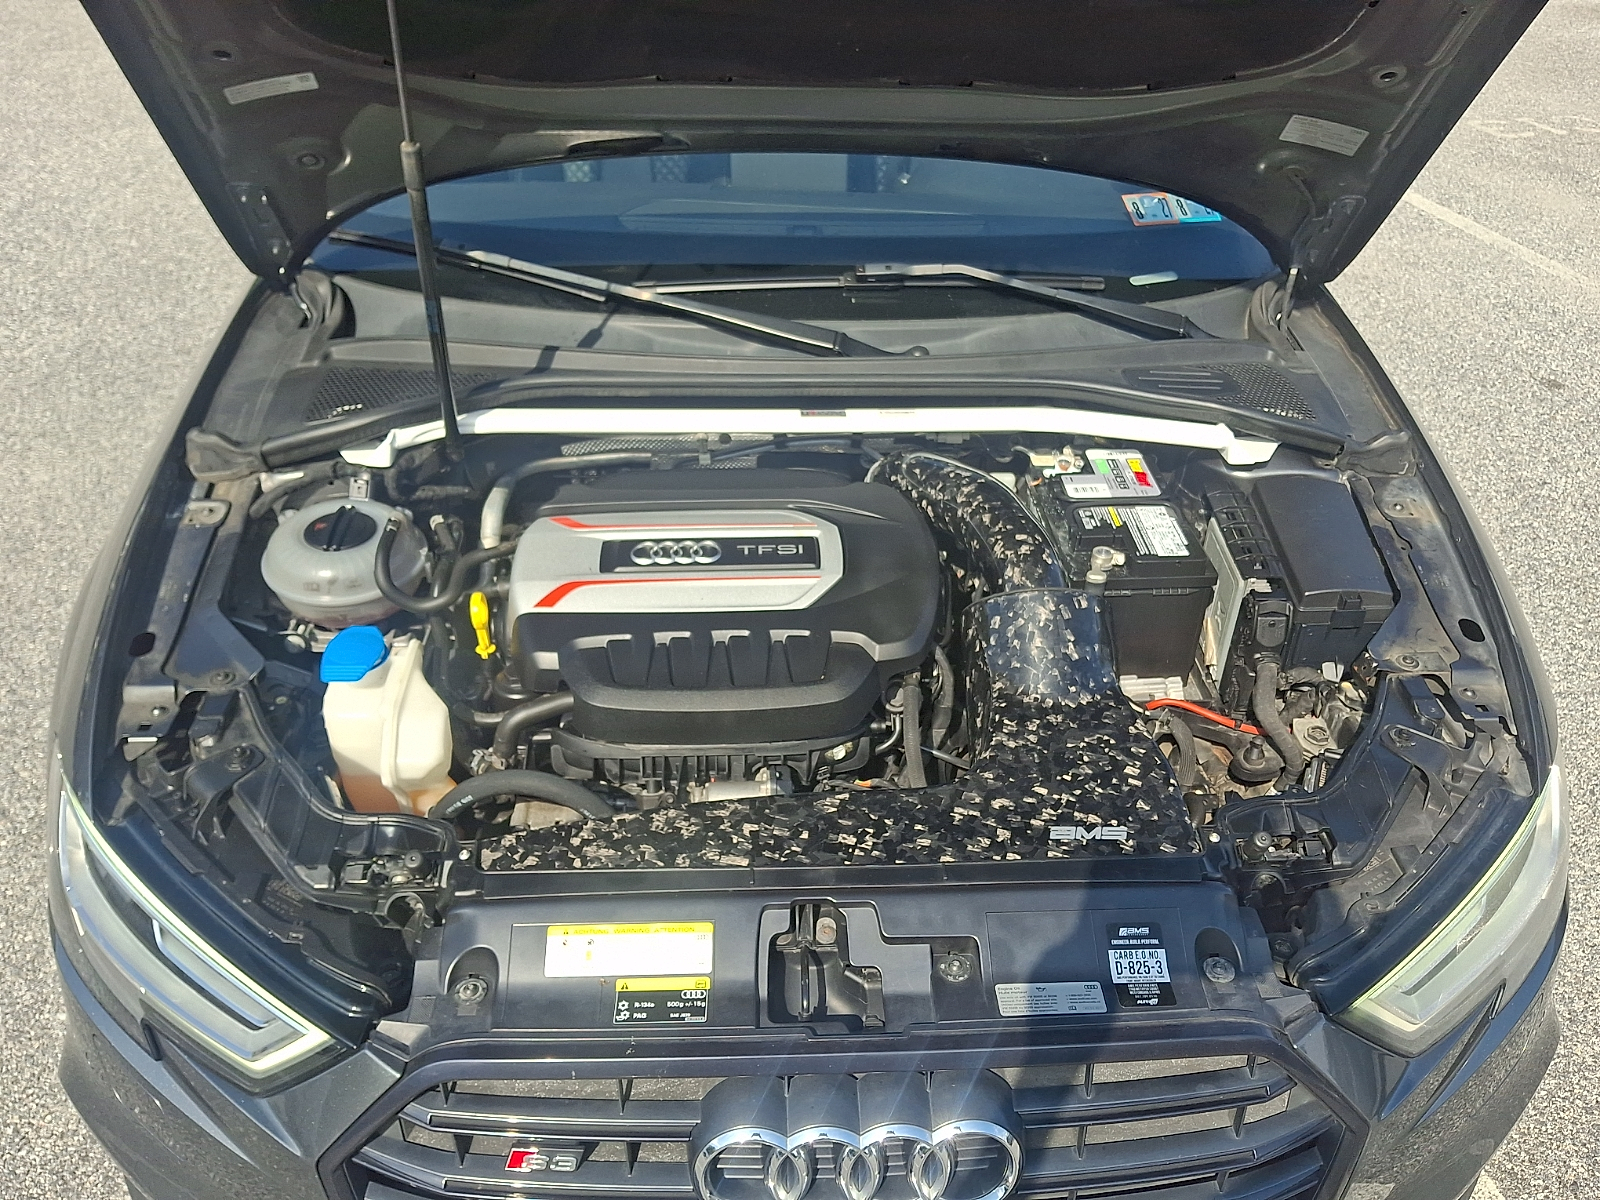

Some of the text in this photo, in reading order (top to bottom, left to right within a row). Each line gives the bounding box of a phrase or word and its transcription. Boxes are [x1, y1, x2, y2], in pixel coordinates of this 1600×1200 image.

[1131, 201, 1144, 219] 8
[1176, 199, 1188, 216] 8
[736, 544, 804, 555] TFSI
[1115, 960, 1163, 975] D-825-3
[521, 1154, 578, 1172] S3
